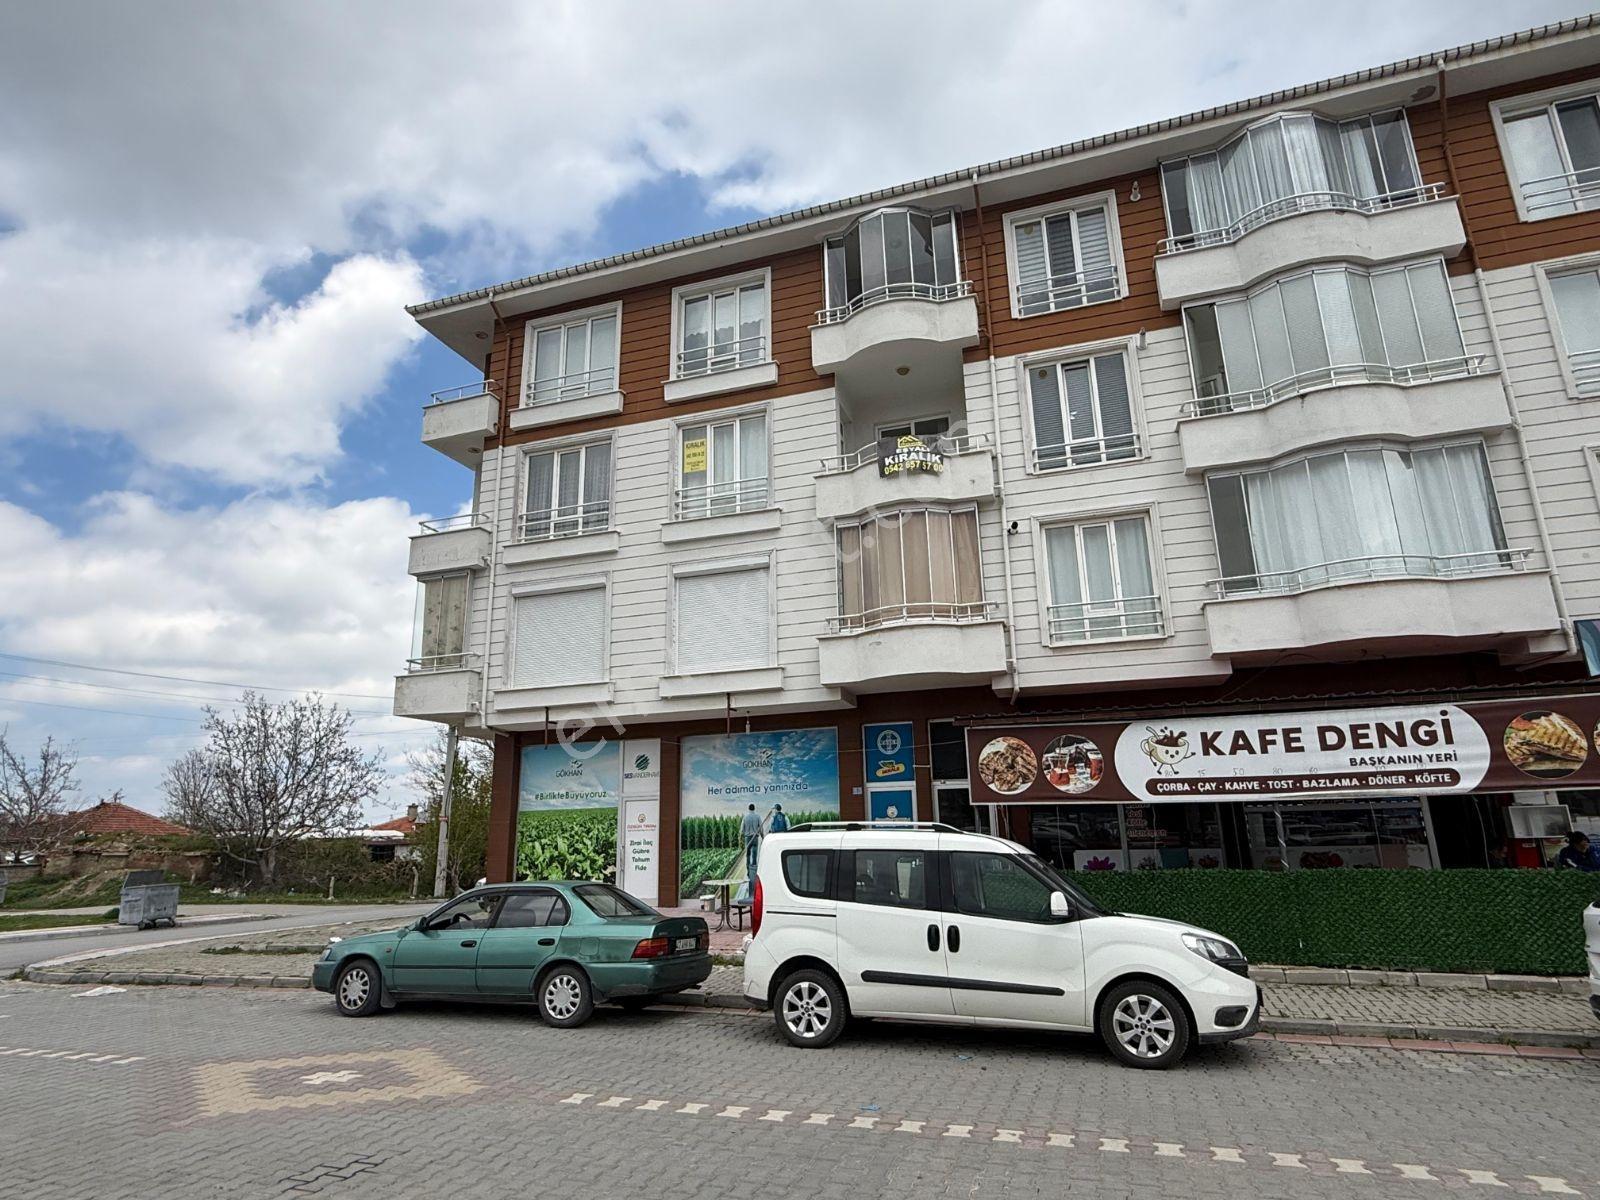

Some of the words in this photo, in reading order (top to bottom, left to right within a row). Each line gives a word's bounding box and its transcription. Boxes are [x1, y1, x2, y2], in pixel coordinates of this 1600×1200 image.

[884, 463, 903, 475] 0542
[1200, 728, 1305, 756] KAFE
[1317, 709, 1455, 752] DENGİ
[1349, 754, 1423, 766] BAŞKANIN
[1426, 750, 1458, 763] YERİ
[707, 786, 722, 795] Her
[1157, 782, 1190, 793] ÇORBA
[1197, 782, 1217, 792] ÇAY
[1225, 780, 1259, 790] KAHVE
[1267, 779, 1294, 789] TOST
[1302, 777, 1360, 788] BAZLAMA
[1368, 774, 1406, 785] DÖNER
[1415, 773, 1452, 783] KÖFTE
